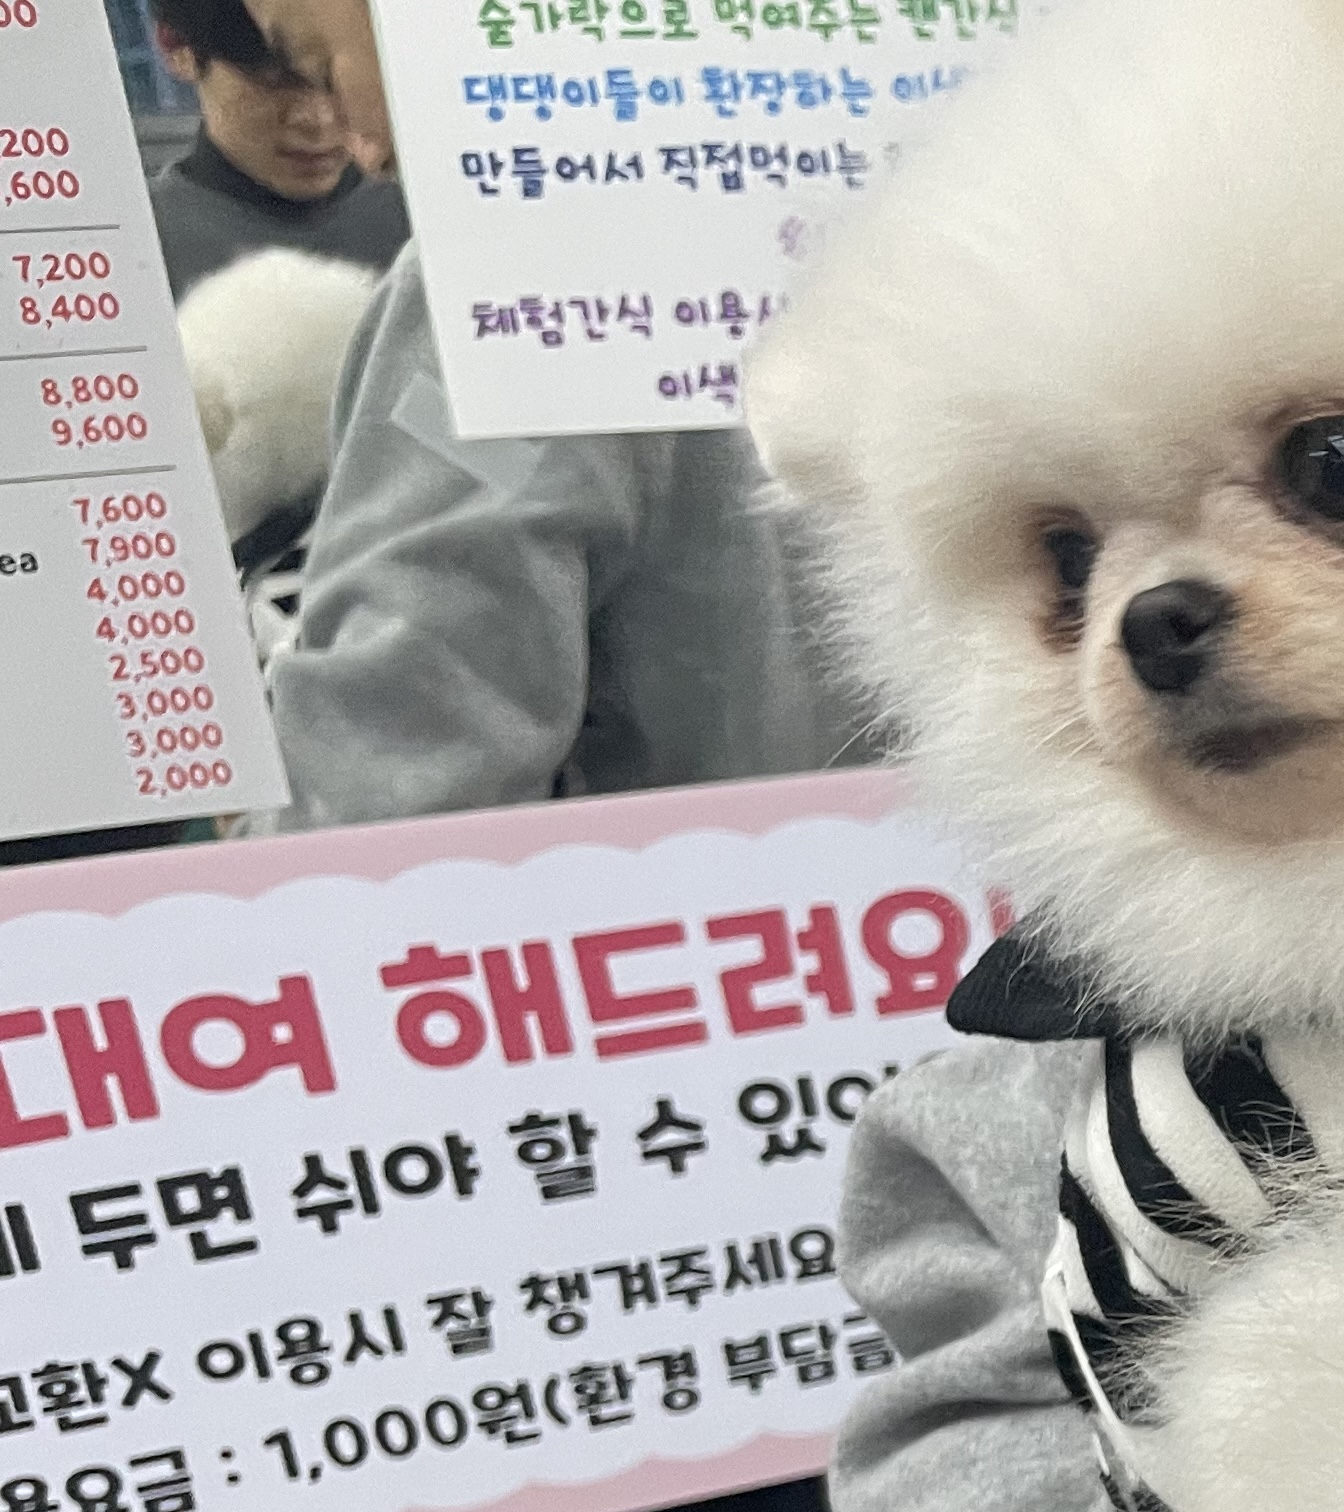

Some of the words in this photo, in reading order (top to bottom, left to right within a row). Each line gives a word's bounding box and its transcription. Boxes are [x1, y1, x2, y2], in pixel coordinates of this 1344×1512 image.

[714, 0, 881, 44] 먹여주는
[463, 69, 684, 122] 댕댕이들이
[701, 67, 873, 118] 환장하는
[461, 147, 643, 199] 만들어서
[658, 142, 867, 193] 직접먹이는
[12, 252, 110, 289] 7,200
[20, 292, 119, 330] 8,400
[472, 295, 653, 347] 체험간식
[41, 374, 138, 408] 8,800
[52, 412, 147, 449] 9,600
[73, 492, 166, 529] 7,600
[82, 531, 175, 568] 7,900
[87, 570, 185, 607] 4,000
[96, 609, 194, 645] 4,000
[109, 646, 204, 683] 2,500
[117, 685, 213, 722] 3,000
[126, 722, 222, 759] 3,000
[136, 759, 232, 796] 2,000
[0, 975, 337, 1151] 대여
[69, 1167, 258, 1269] 두면
[292, 1134, 479, 1234] 쉬야
[507, 1112, 597, 1201] 할
[637, 1099, 706, 1175] 수
[197, 1307, 405, 1386] 이용시
[426, 1290, 492, 1356] 잘
[519, 1229, 836, 1335] 챙겨주세요
[263, 1350, 700, 1483] 1,000원(환경
